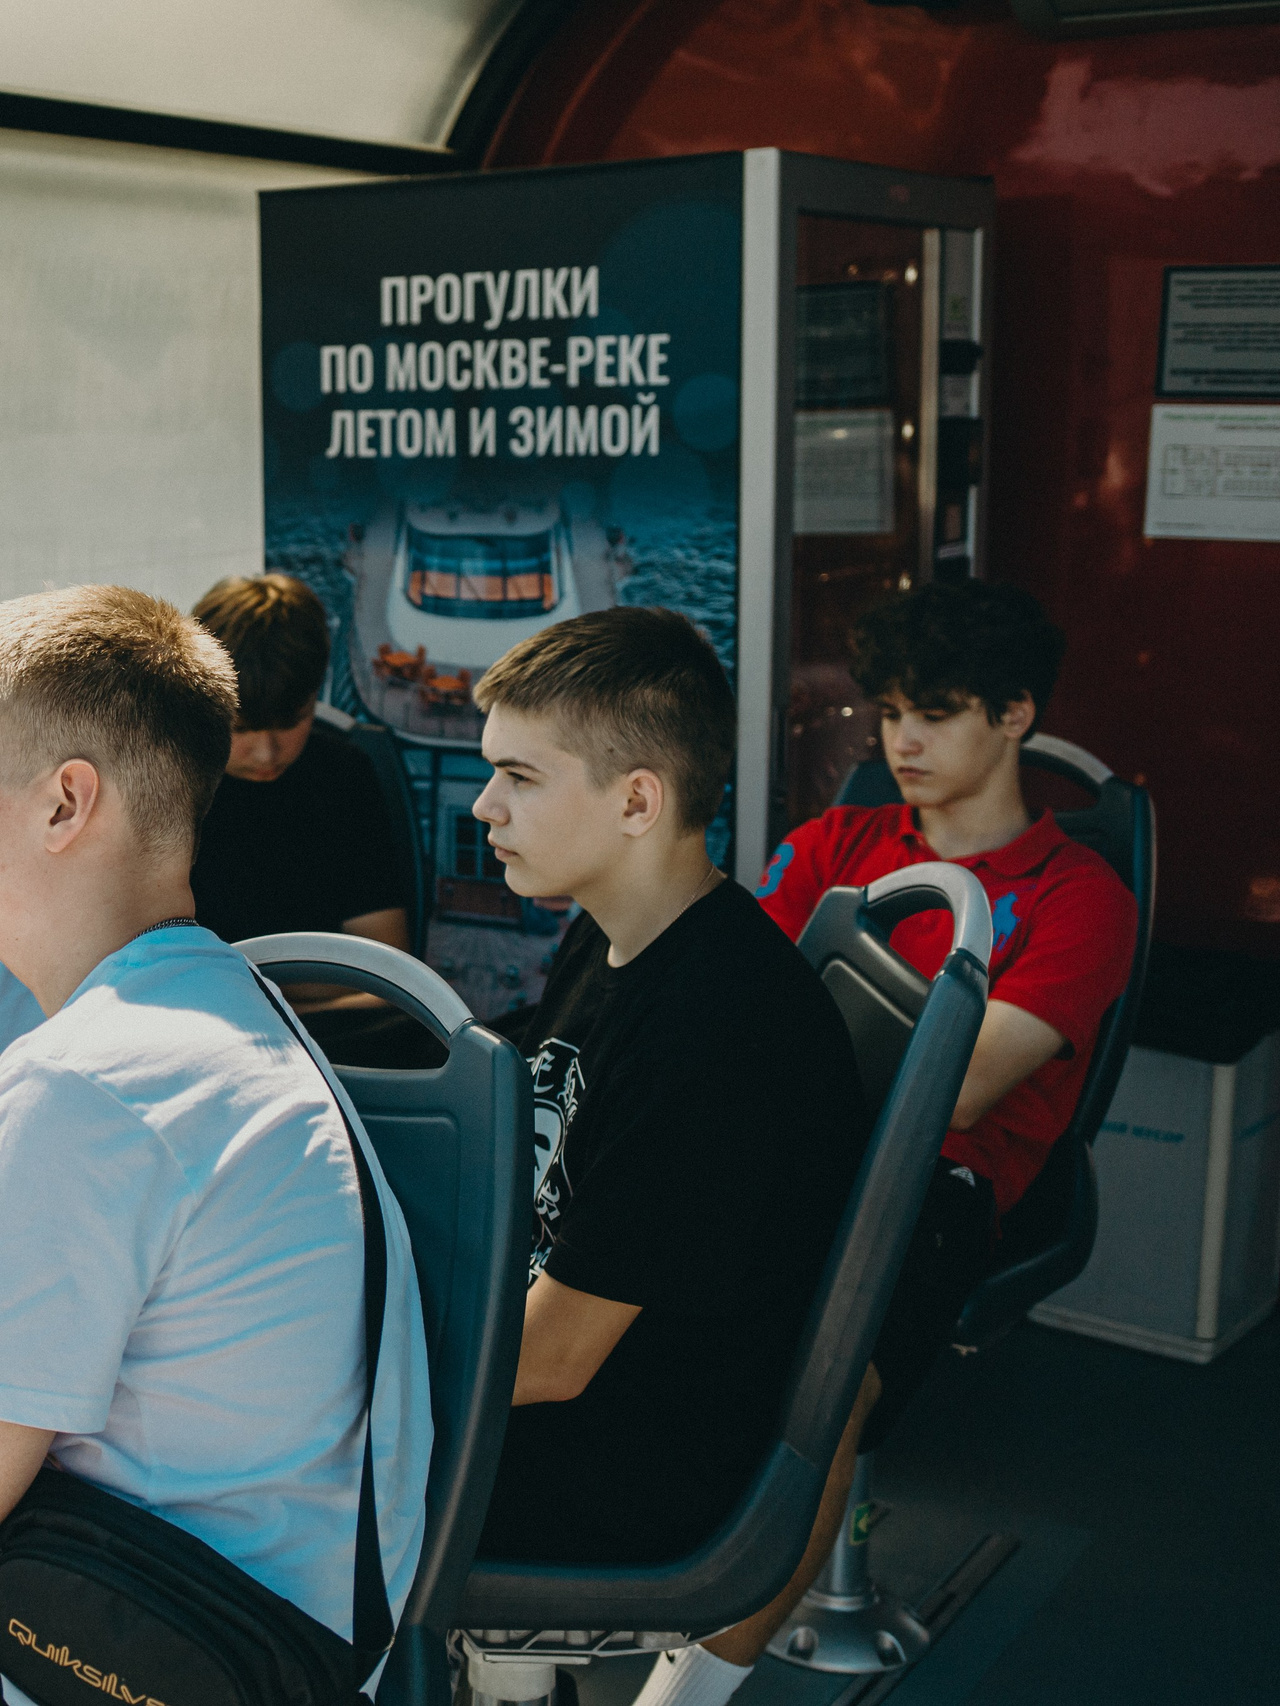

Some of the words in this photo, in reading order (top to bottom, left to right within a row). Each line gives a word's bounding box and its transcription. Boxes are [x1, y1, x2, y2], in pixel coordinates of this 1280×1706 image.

[380, 266, 599, 330] ПРОГУЛКИ
[320, 344, 374, 393] ПО
[386, 333, 670, 391] МОСКВЕ-РЕКЕ
[325, 408, 457, 458] ЛЕТОМ
[469, 407, 497, 456] И
[508, 392, 660, 457] ЗИМОЙ
